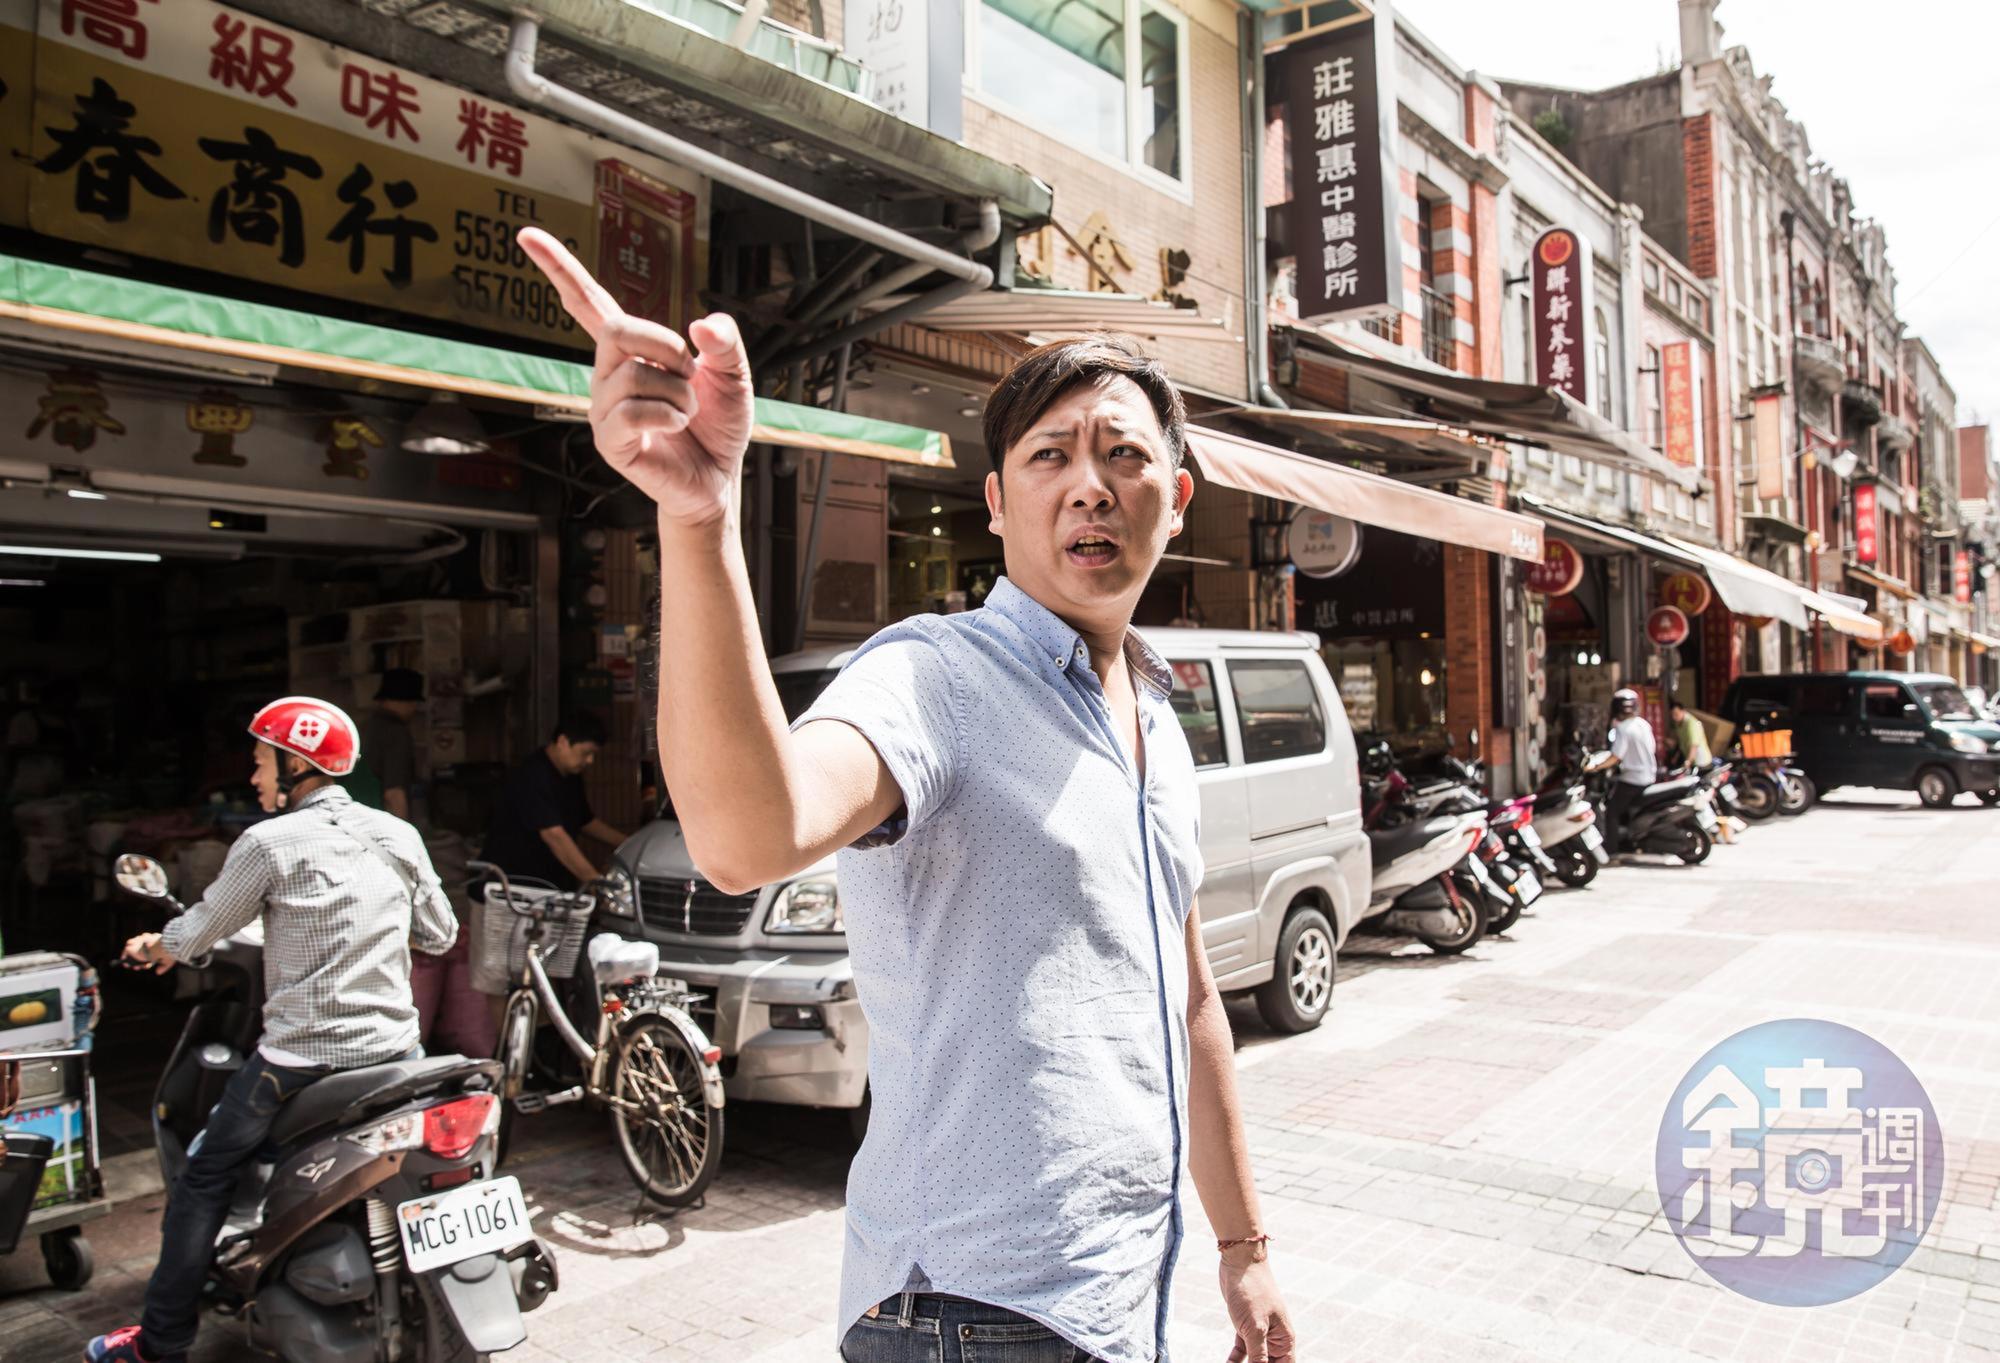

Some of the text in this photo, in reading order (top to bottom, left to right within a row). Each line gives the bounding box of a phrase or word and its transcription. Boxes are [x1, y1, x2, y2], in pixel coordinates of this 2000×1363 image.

[61, 0, 528, 177] 高級味精
[494, 188, 544, 223] TEL
[1313, 56, 1360, 300] 莊雅惠中醫診所
